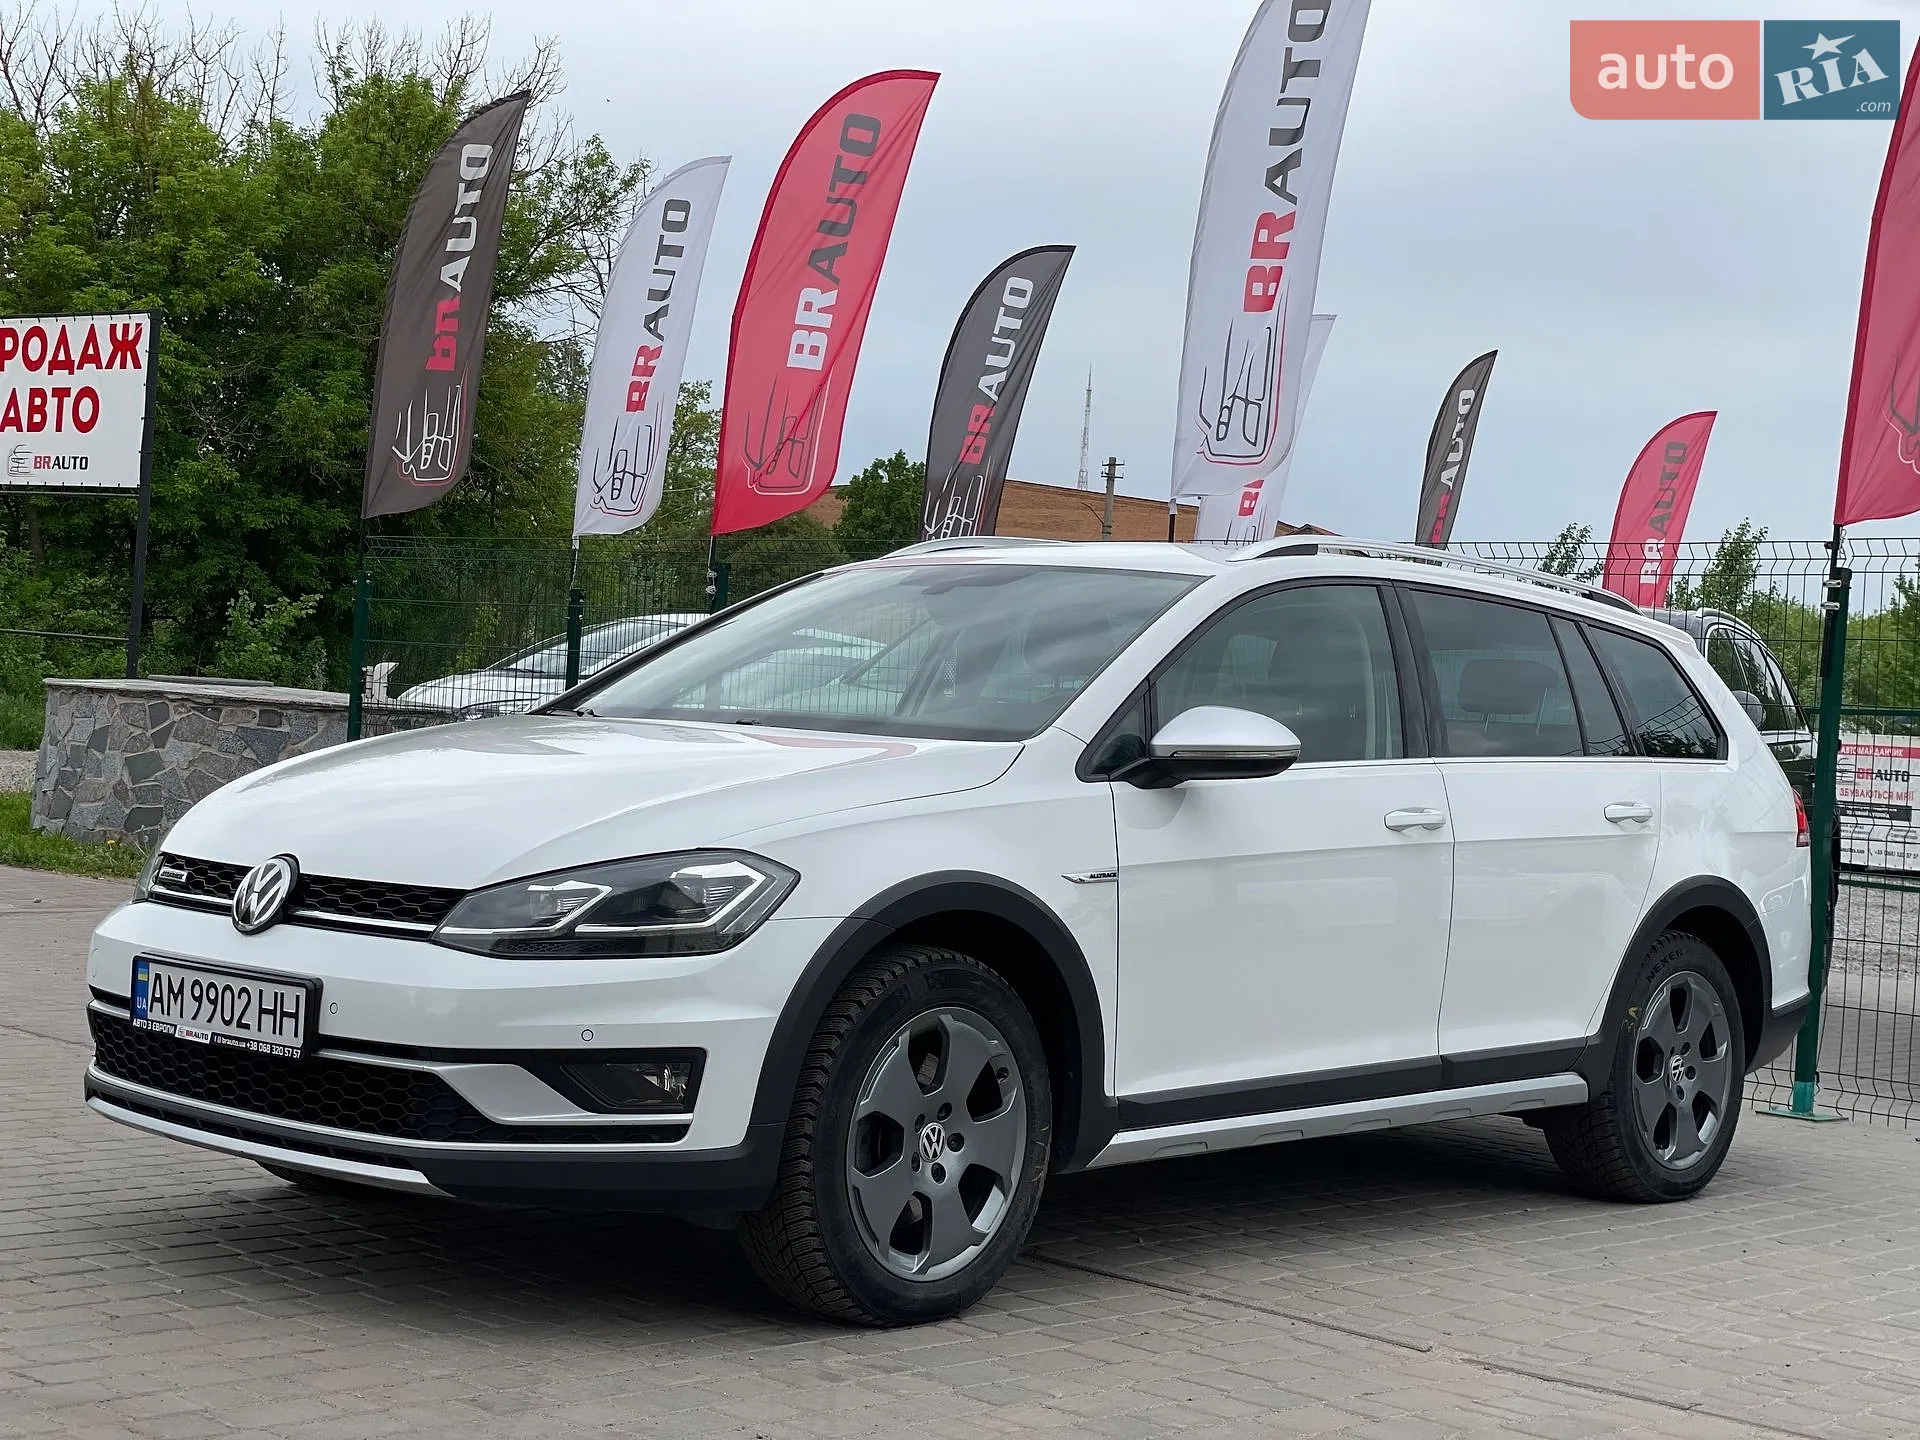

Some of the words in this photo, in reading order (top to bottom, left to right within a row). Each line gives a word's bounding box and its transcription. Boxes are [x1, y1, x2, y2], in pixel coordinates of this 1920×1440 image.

[1243, 0, 1332, 313] BRAUTO
[786, 112, 882, 372] BRAUTO
[625, 198, 692, 413] BRAUTO
[959, 276, 1035, 465] BRAUTO
[0, 386, 100, 434] АВТО
[33, 455, 89, 470] BRAUTO
[1639, 441, 1688, 584] BRAUTO
[1856, 767, 1911, 782] BRAUTO
[132, 1018, 147, 1029] АВТО
[136, 996, 147, 1010] UA
[149, 972, 185, 1019] AM
[190, 978, 252, 1030] 9902
[257, 988, 300, 1038] HH
[185, 1030, 209, 1041] BRAUTO
[246, 1041, 258, 1051] +38
[284, 1047, 293, 1058] 57
[292, 1049, 301, 1059] 57
